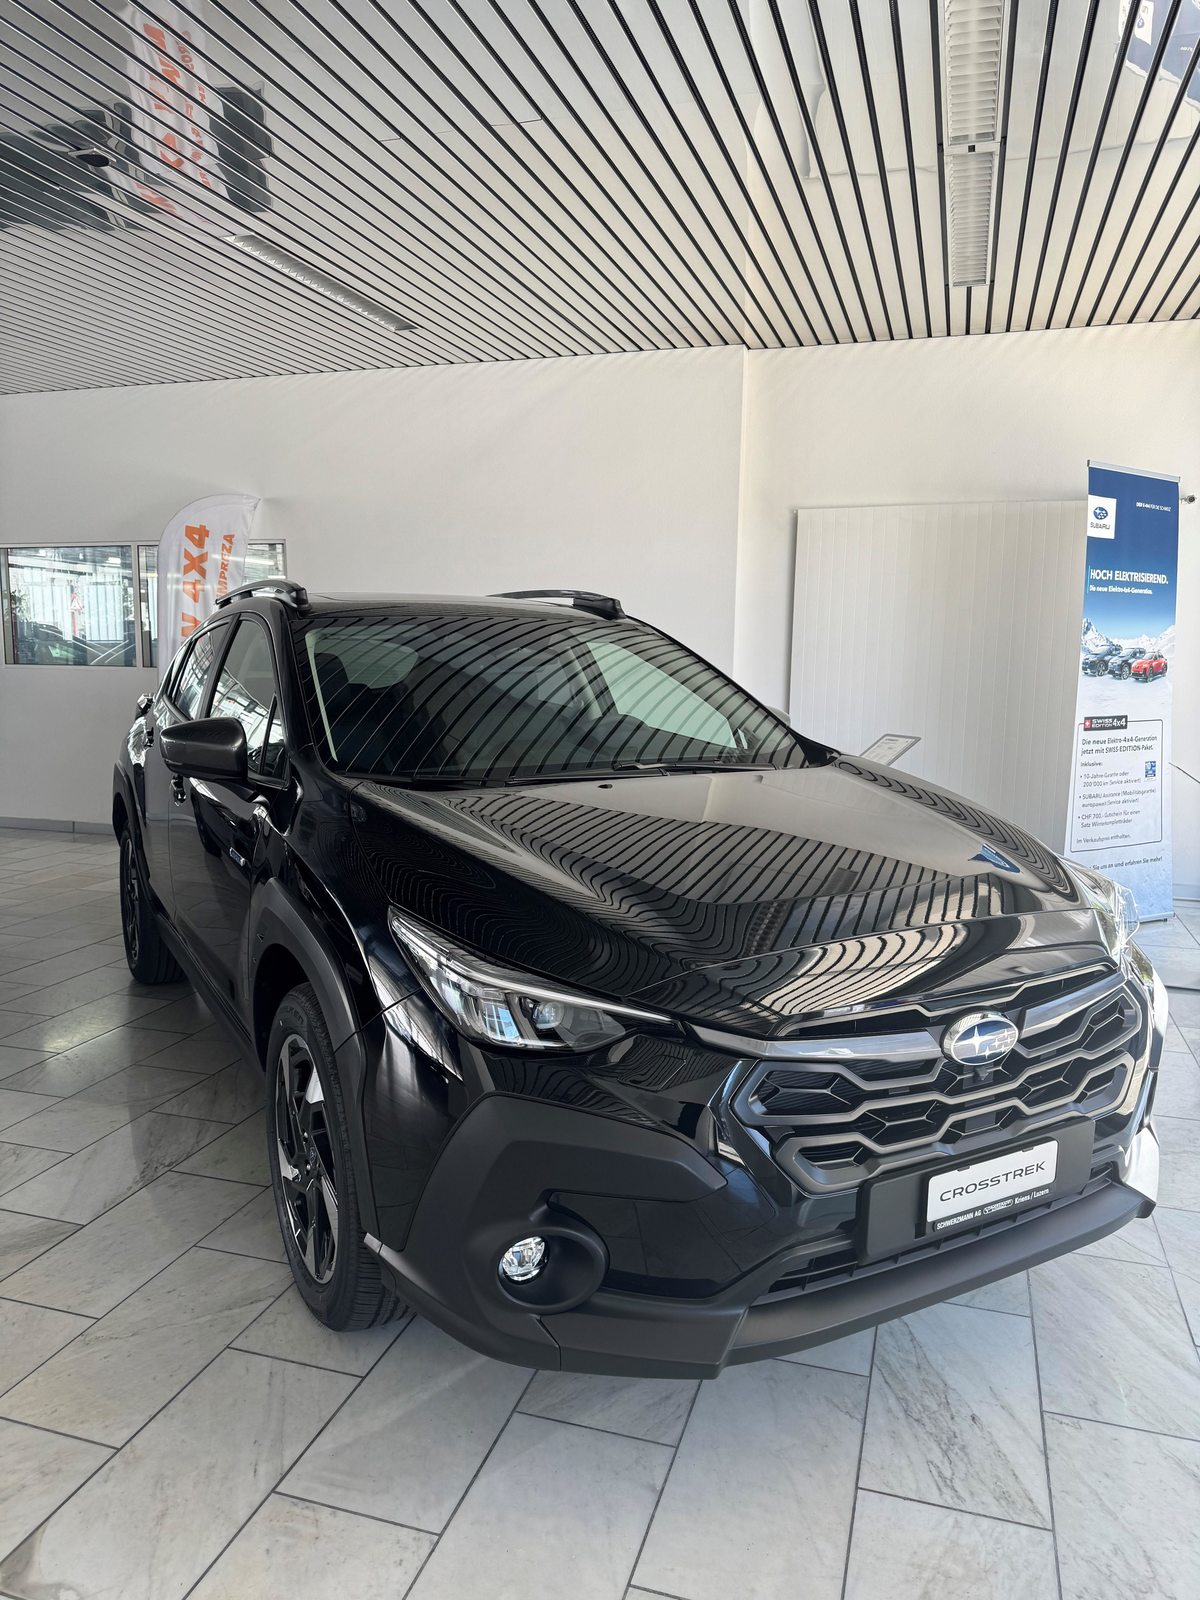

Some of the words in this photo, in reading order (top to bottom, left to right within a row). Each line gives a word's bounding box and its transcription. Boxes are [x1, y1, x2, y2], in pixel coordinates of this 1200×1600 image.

[1090, 522, 1110, 530] SUBARU
[183, 524, 210, 603] 4X4
[1090, 569, 1112, 580] HOCH
[1114, 571, 1168, 584] ELEKTRISIEREND.
[1113, 718, 1126, 727] 4x4
[1081, 748, 1093, 756] jetzt
[940, 1161, 1046, 1202] CROSSTREK
[936, 1212, 974, 1230] SCHWERZMANN
[974, 1209, 982, 1218] AG
[1014, 1194, 1031, 1205] Kriens
[1034, 1188, 1050, 1198] Luzern
